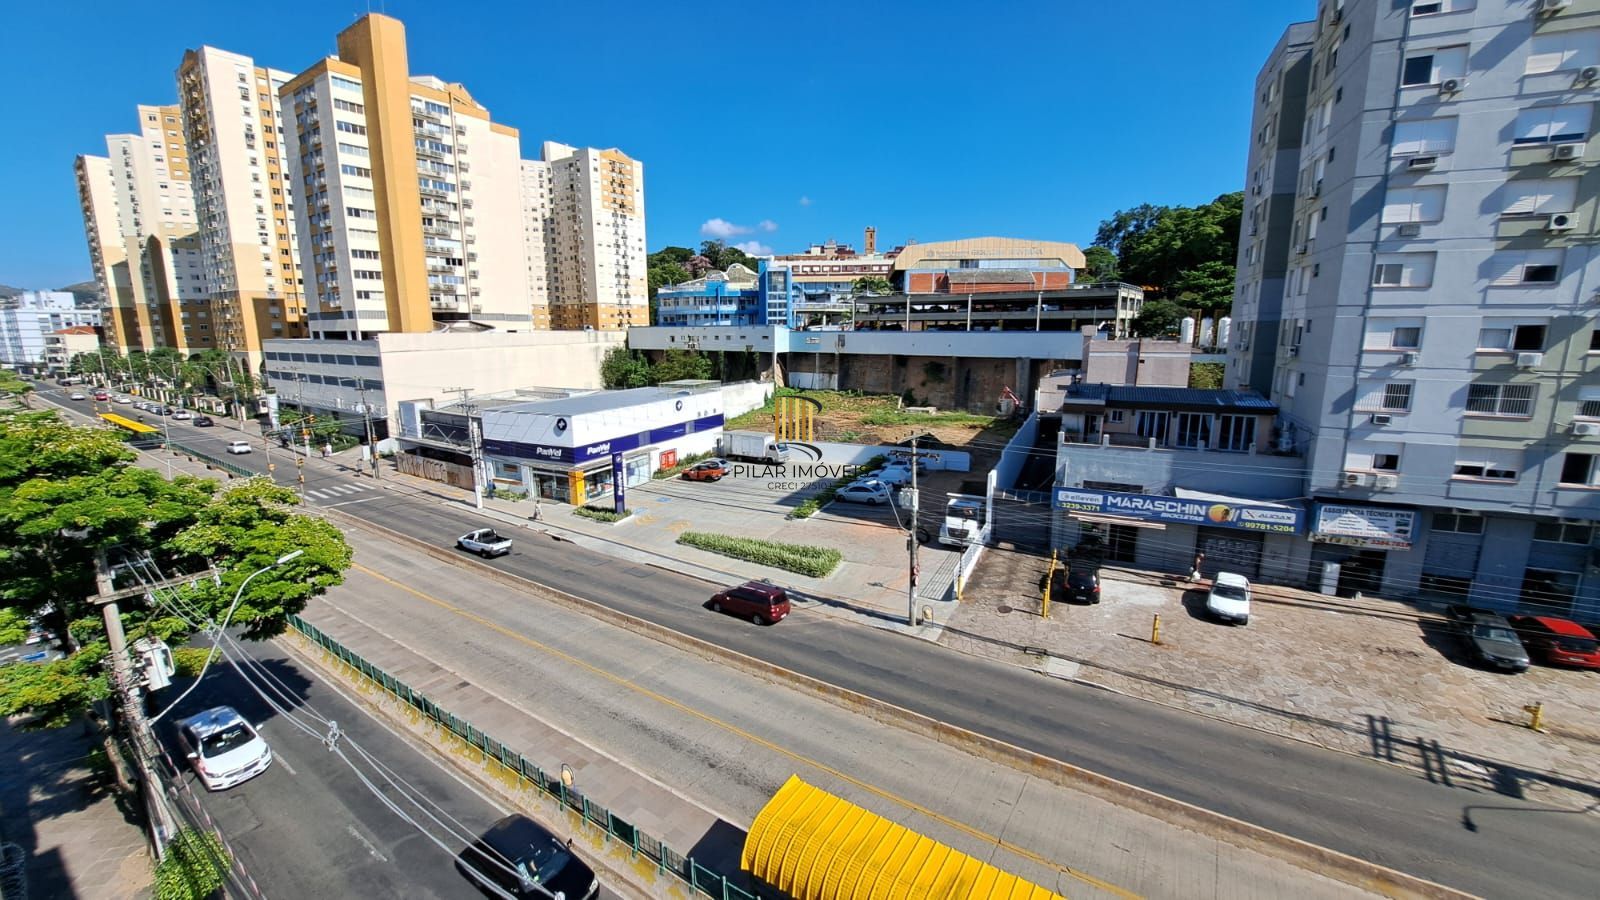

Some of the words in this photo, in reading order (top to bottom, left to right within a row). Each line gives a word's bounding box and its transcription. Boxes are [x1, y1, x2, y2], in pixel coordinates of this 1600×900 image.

[1107, 495, 1206, 515] MARASCHIN
[1258, 513, 1293, 521] AUDAX
[1245, 521, 1295, 532] 99781-5204
